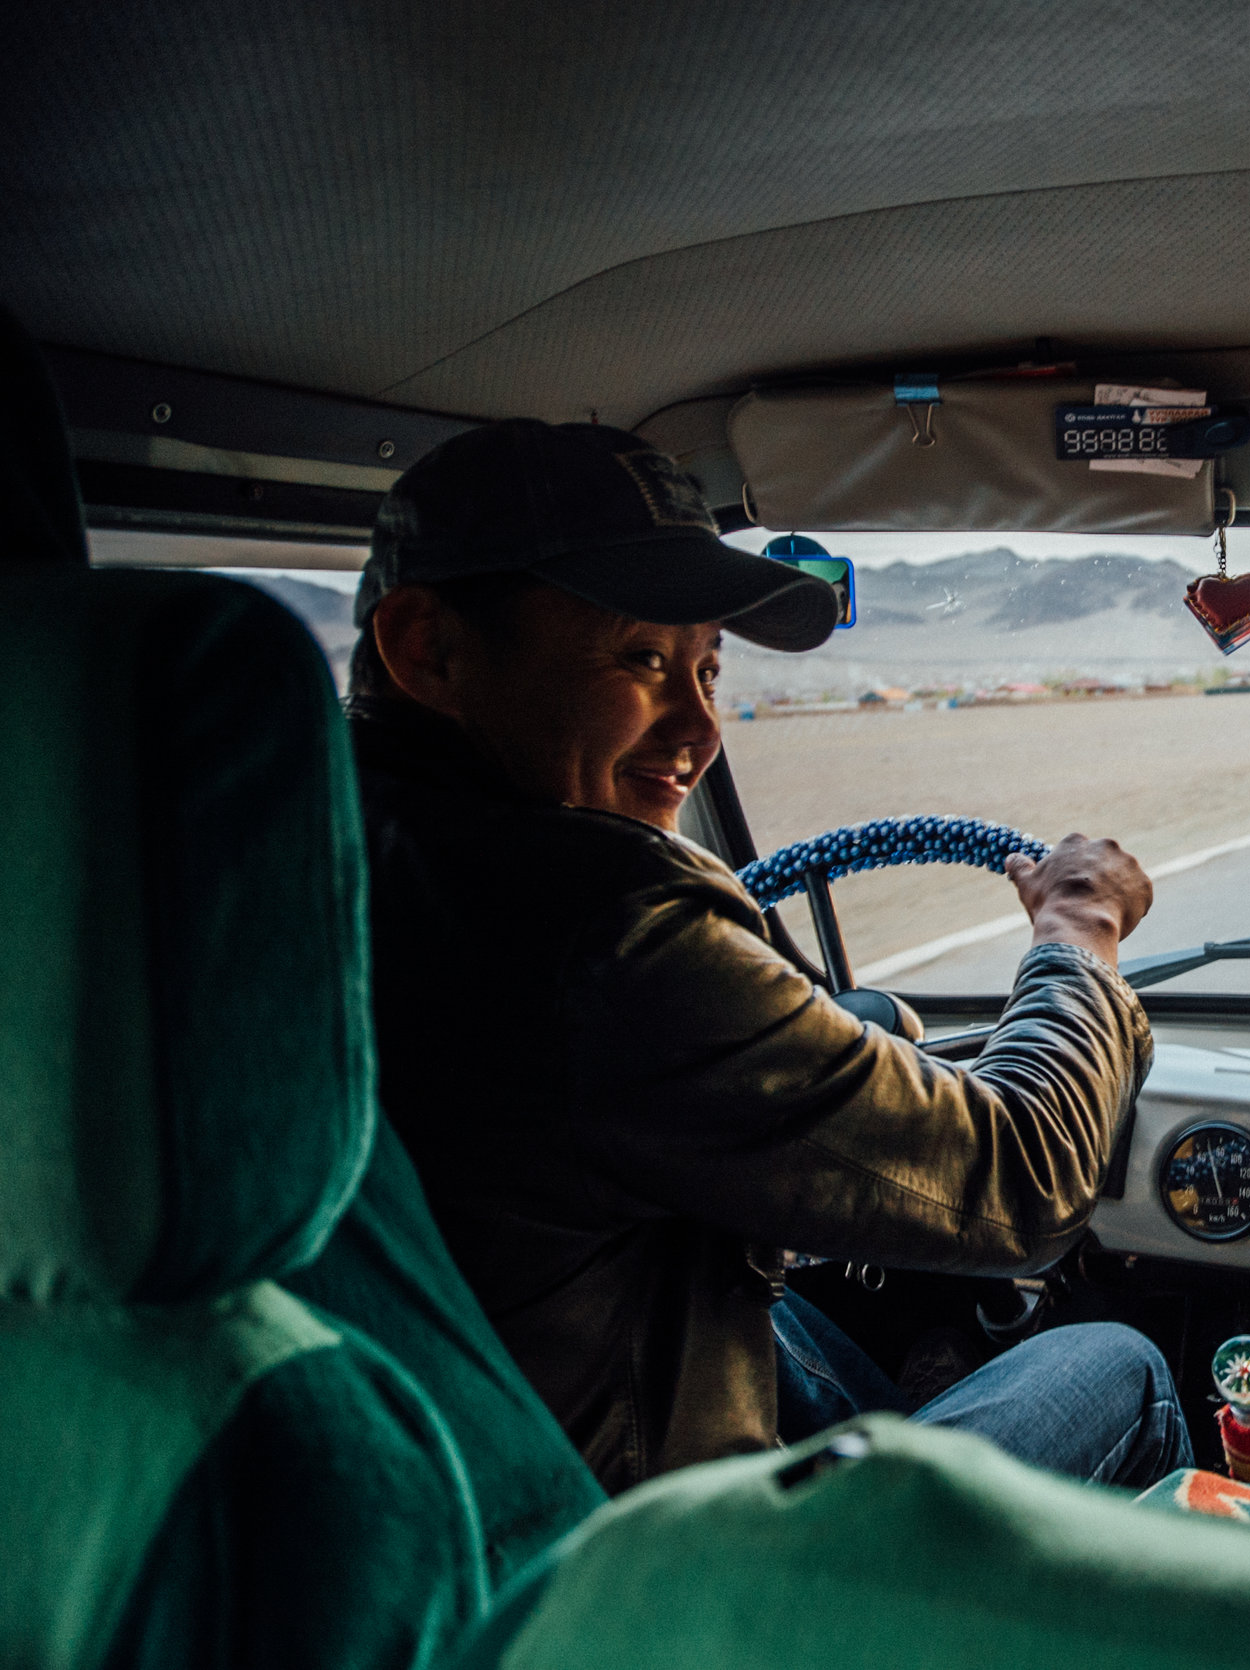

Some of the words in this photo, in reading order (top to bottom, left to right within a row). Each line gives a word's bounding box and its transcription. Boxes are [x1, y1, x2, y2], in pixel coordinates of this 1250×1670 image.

[1239, 1168, 1250, 1178] 120
[1239, 1188, 1250, 1198] 140
[1227, 1206, 1239, 1217] 160
